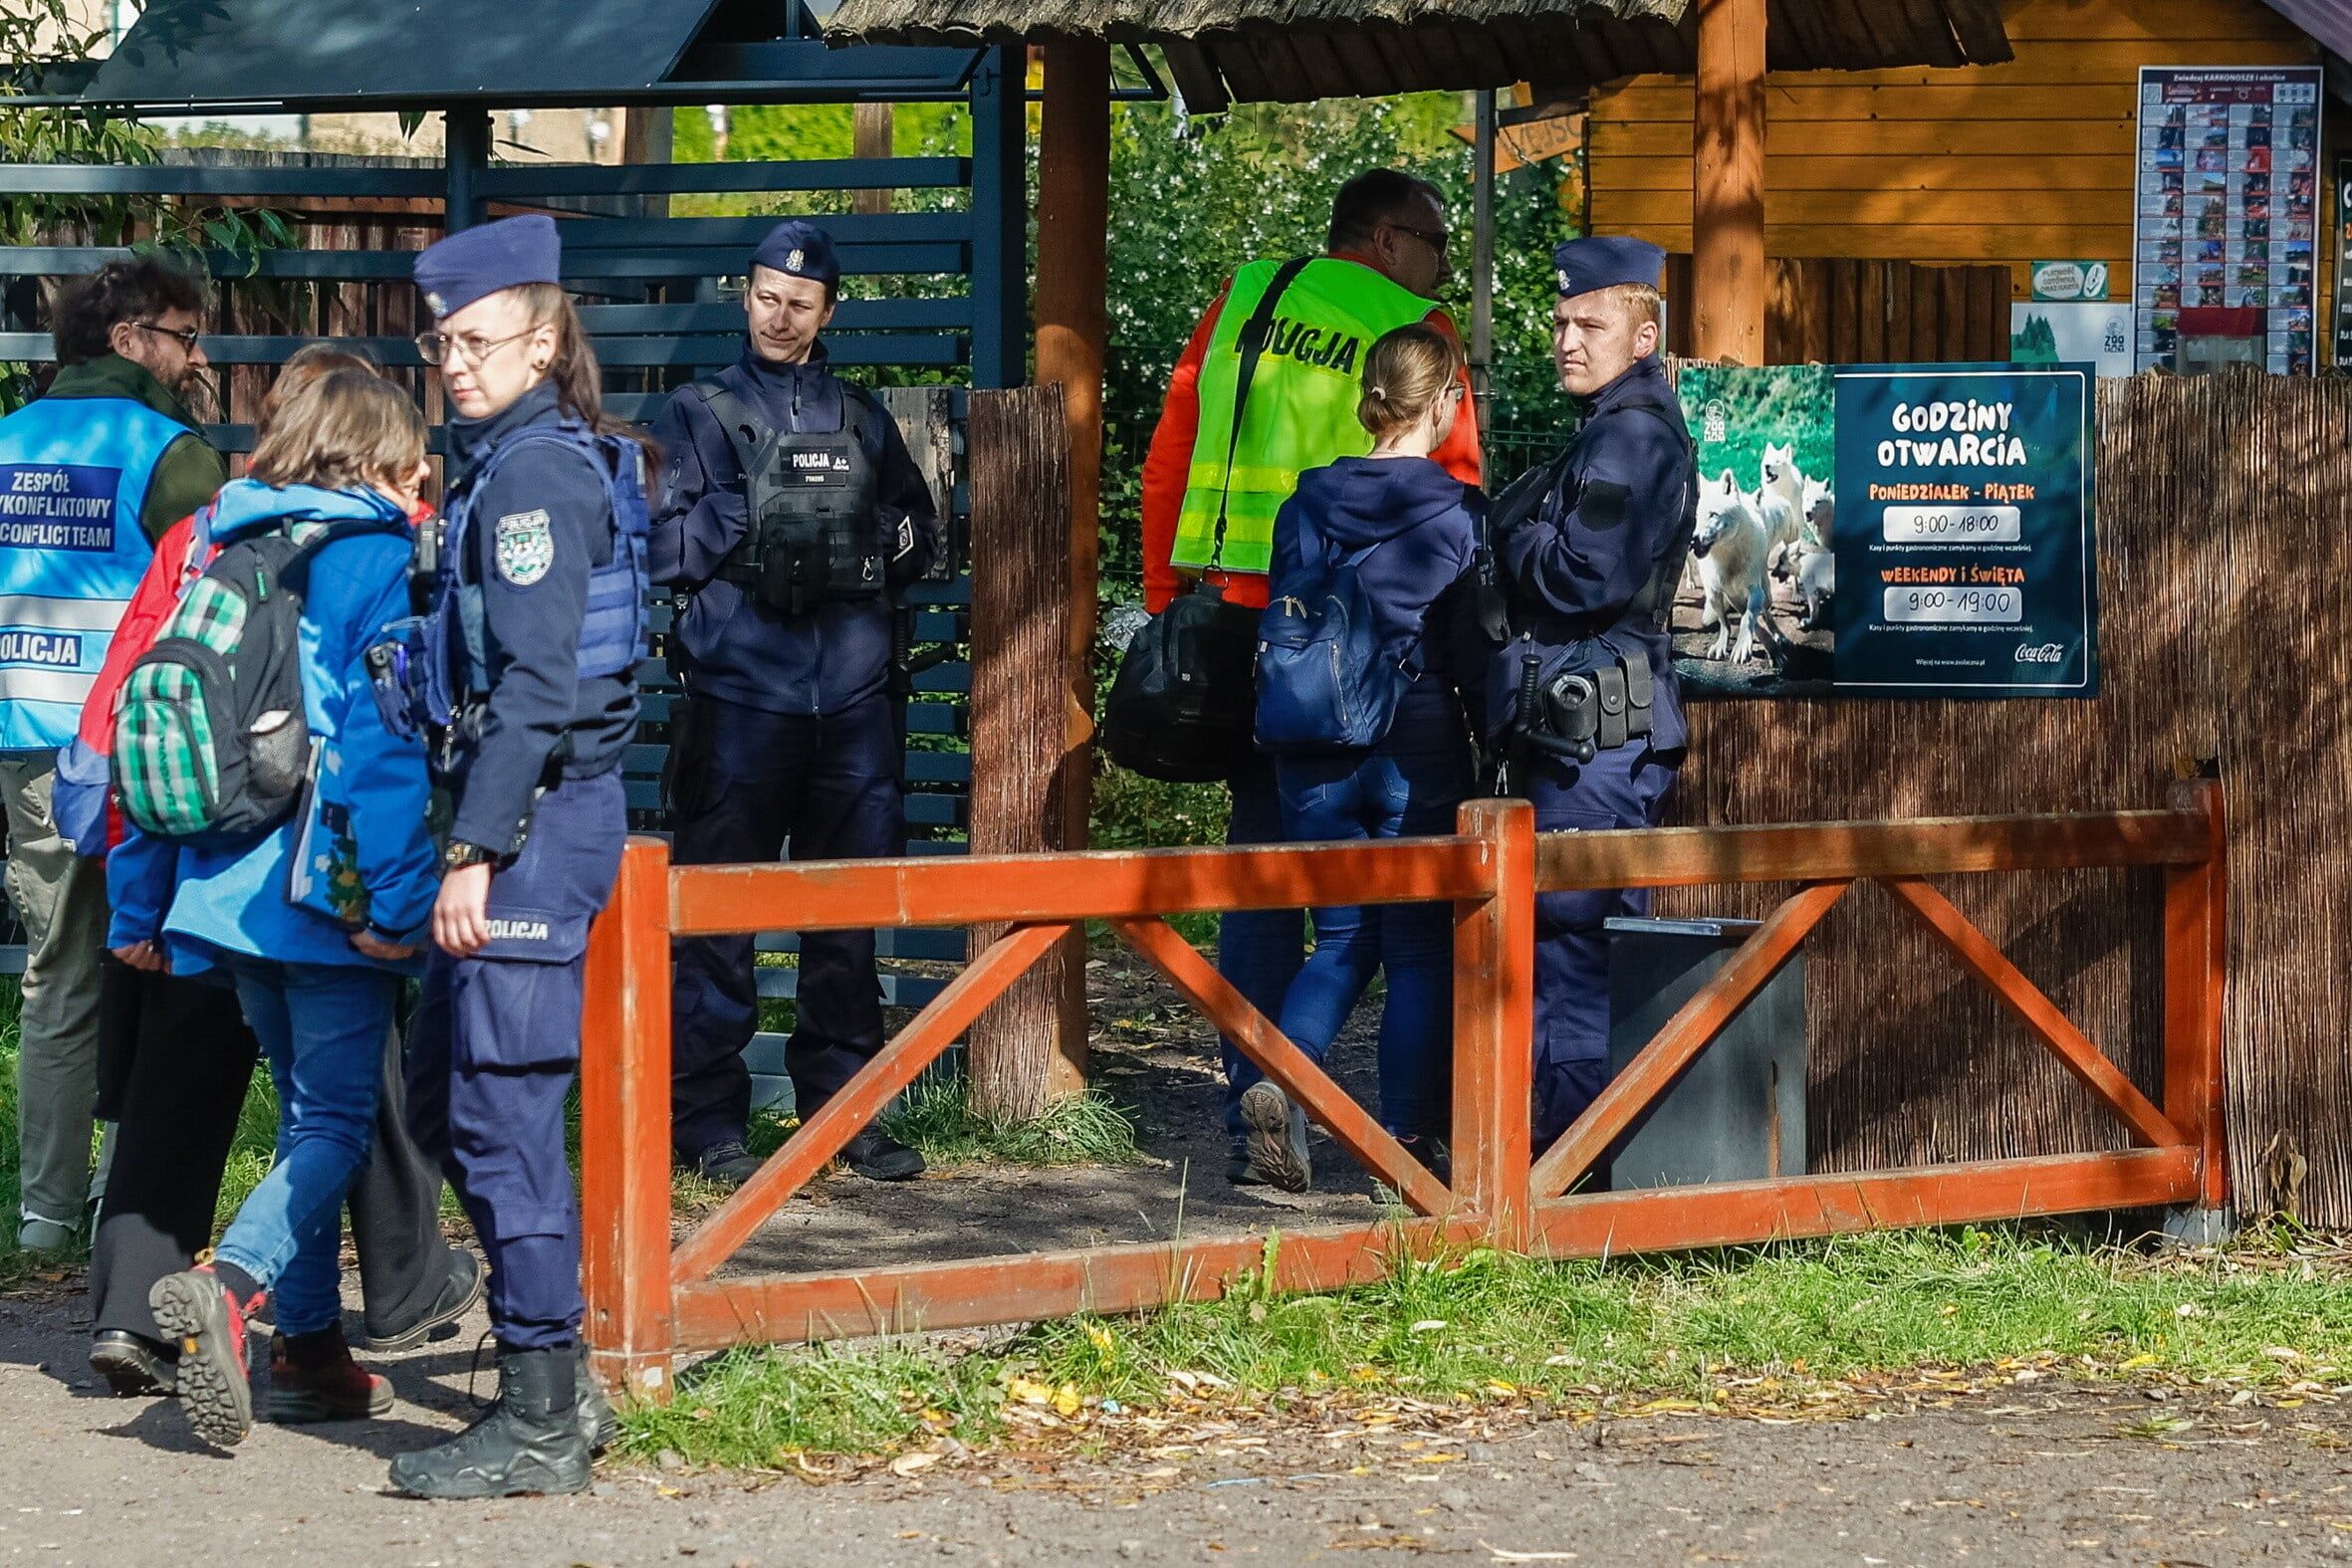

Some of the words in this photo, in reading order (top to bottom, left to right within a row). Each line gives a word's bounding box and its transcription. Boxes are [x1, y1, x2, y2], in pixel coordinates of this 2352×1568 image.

[2104, 336, 2125, 346] ZOO
[1892, 398, 2012, 432] GODZINY
[793, 453, 830, 468] POLICJA
[1877, 433, 2027, 467] OTWARCIA
[11, 469, 70, 494] ZESPÓŁ
[1869, 483, 1970, 500] PONIEDZIAŁEK
[1985, 483, 2035, 504] PIĄTEK
[73, 525, 111, 548] TEAM
[1881, 566, 1958, 583] WEEKENDY
